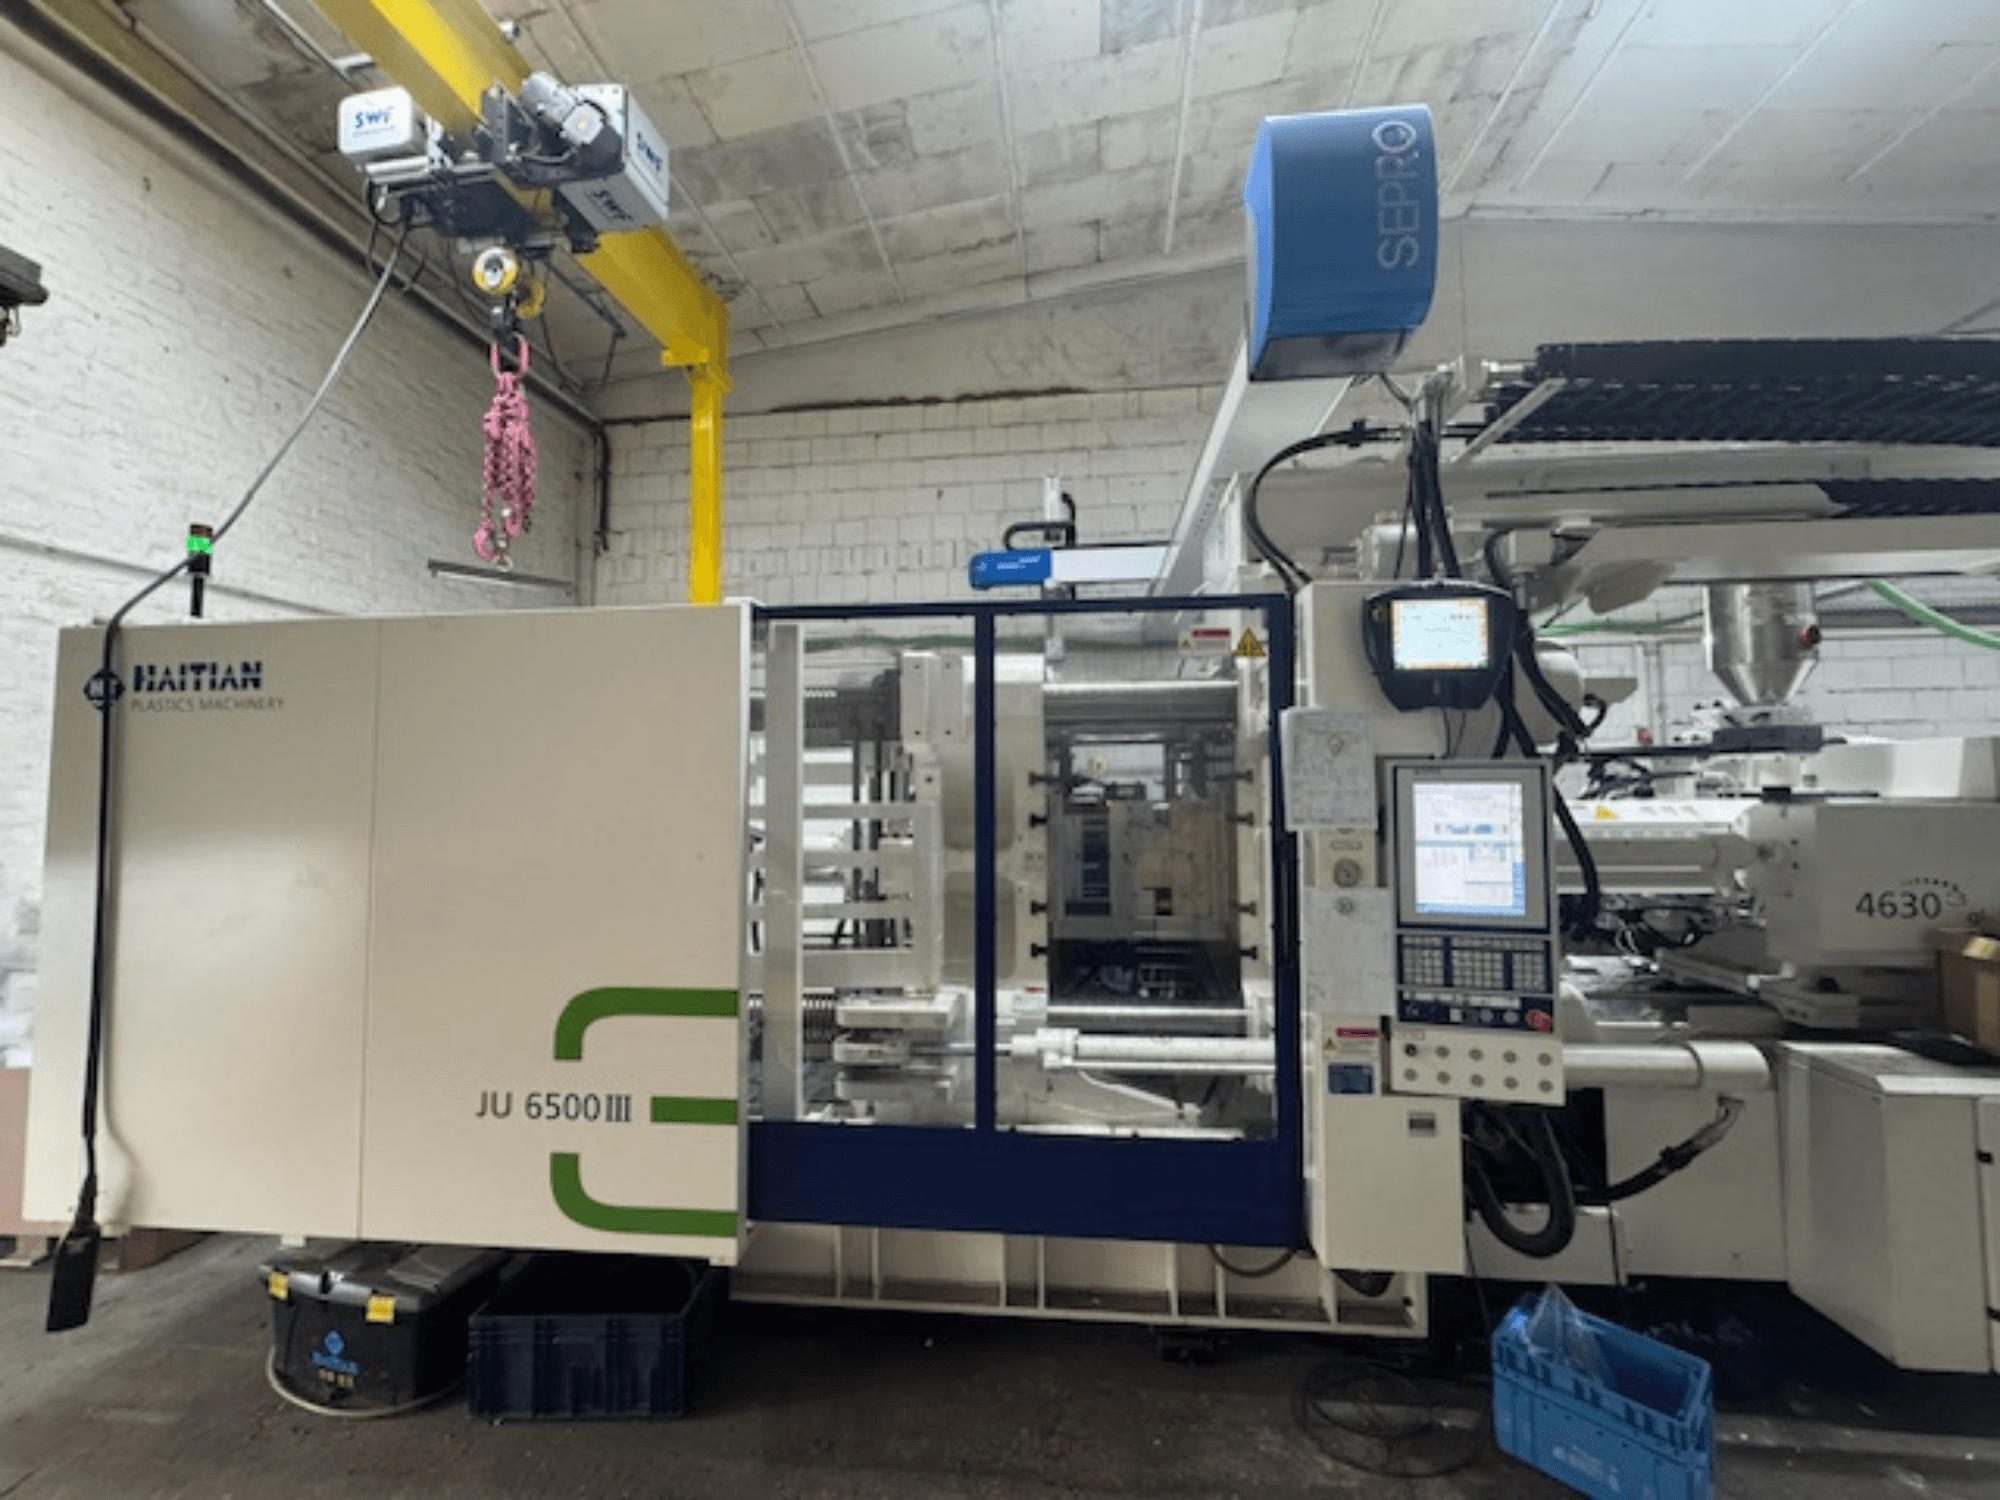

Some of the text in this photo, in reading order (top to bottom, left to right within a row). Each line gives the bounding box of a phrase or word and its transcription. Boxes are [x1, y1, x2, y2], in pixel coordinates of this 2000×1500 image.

[1371, 120, 1420, 269] SEPRO
[132, 659, 263, 692] HAITIAN
[131, 695, 285, 713] PLASTICS MACHINERY
[1856, 890, 1942, 919] 4630
[474, 1089, 513, 1119] JU
